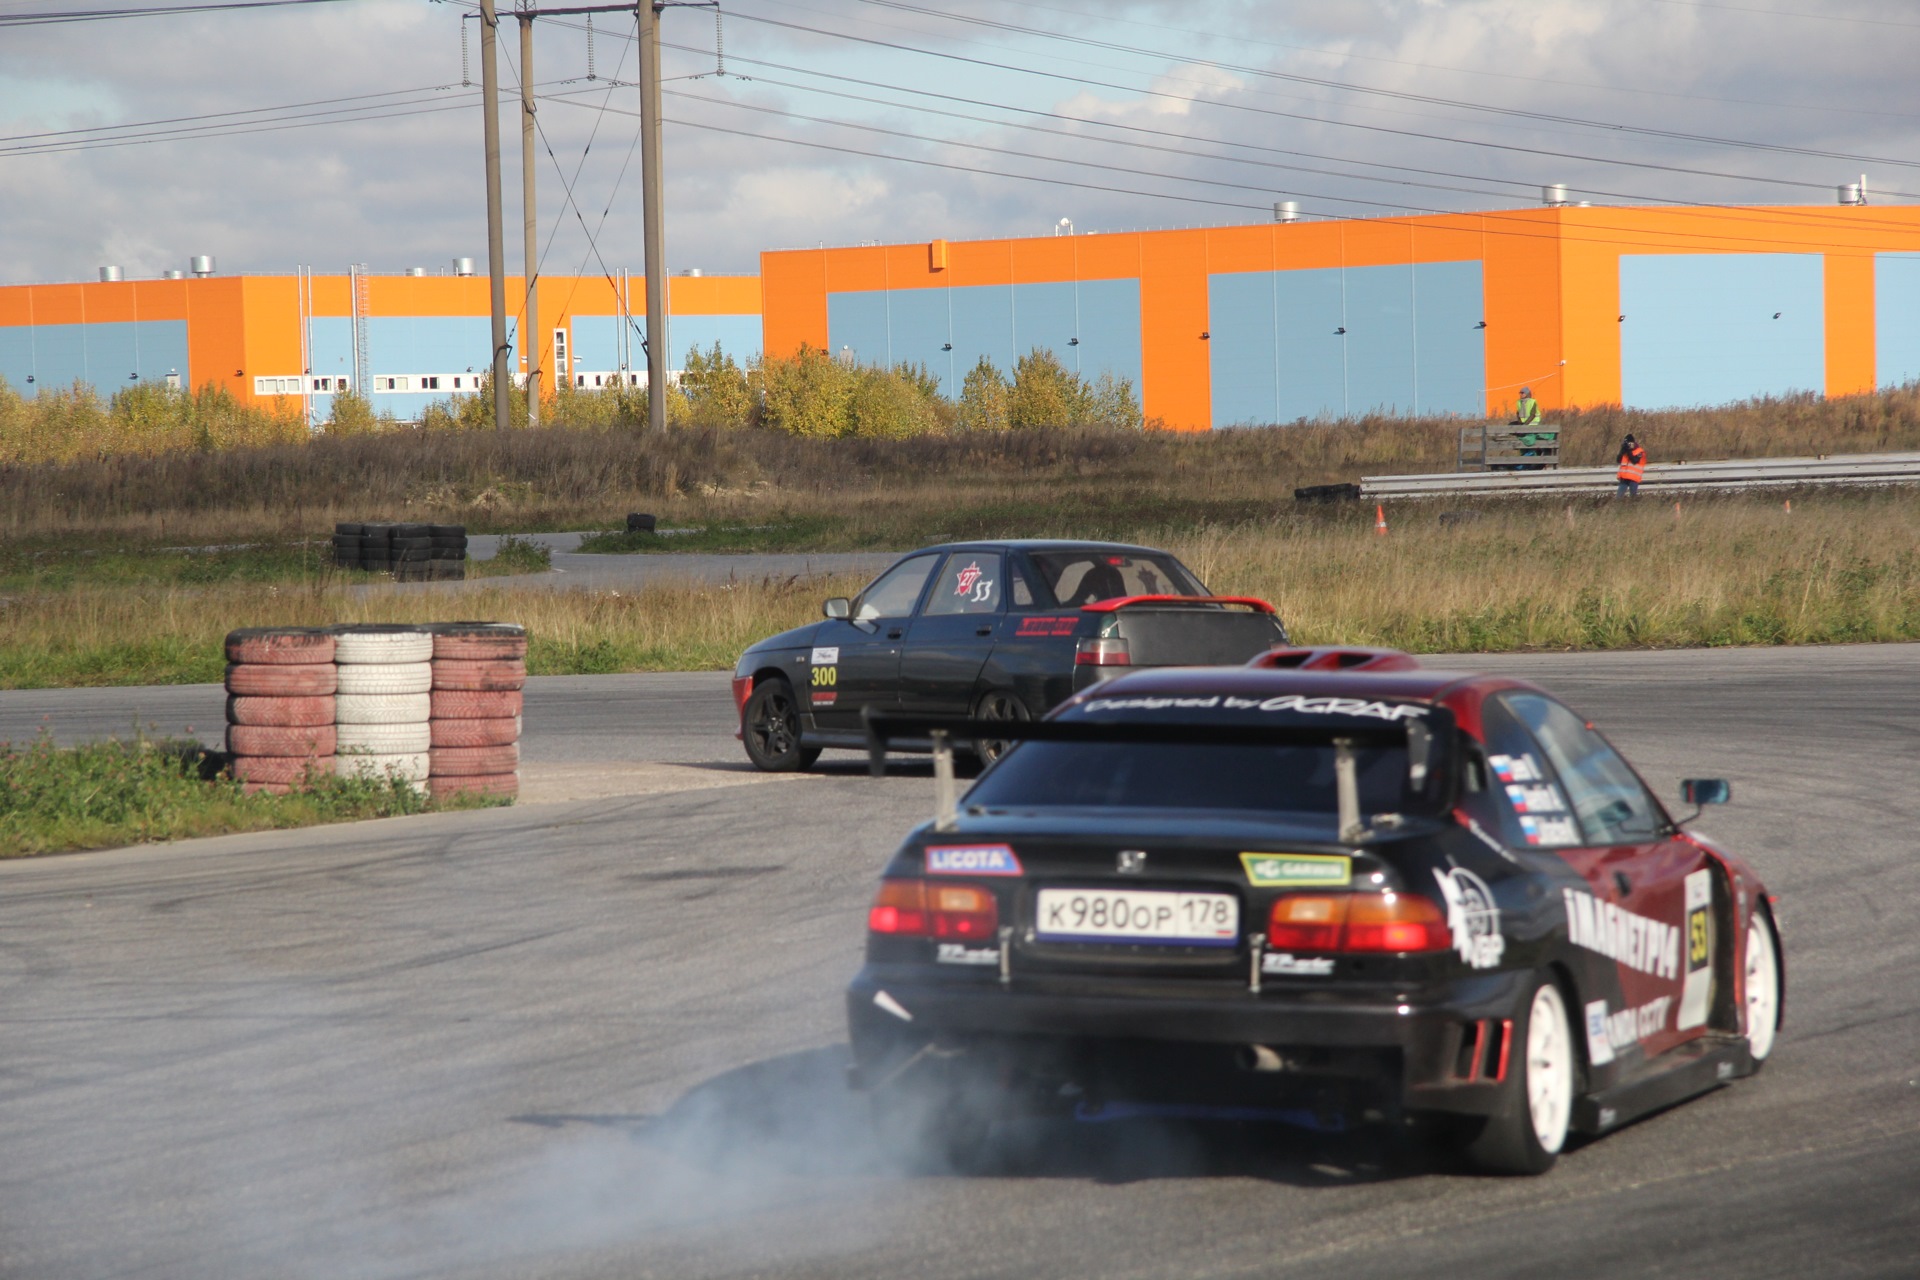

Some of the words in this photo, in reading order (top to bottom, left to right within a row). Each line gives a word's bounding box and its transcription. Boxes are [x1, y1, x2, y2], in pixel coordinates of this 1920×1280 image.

[960, 571, 975, 587] 27
[811, 666, 837, 686] 300
[1222, 695, 1259, 710] by
[931, 850, 1006, 869] LICOTA
